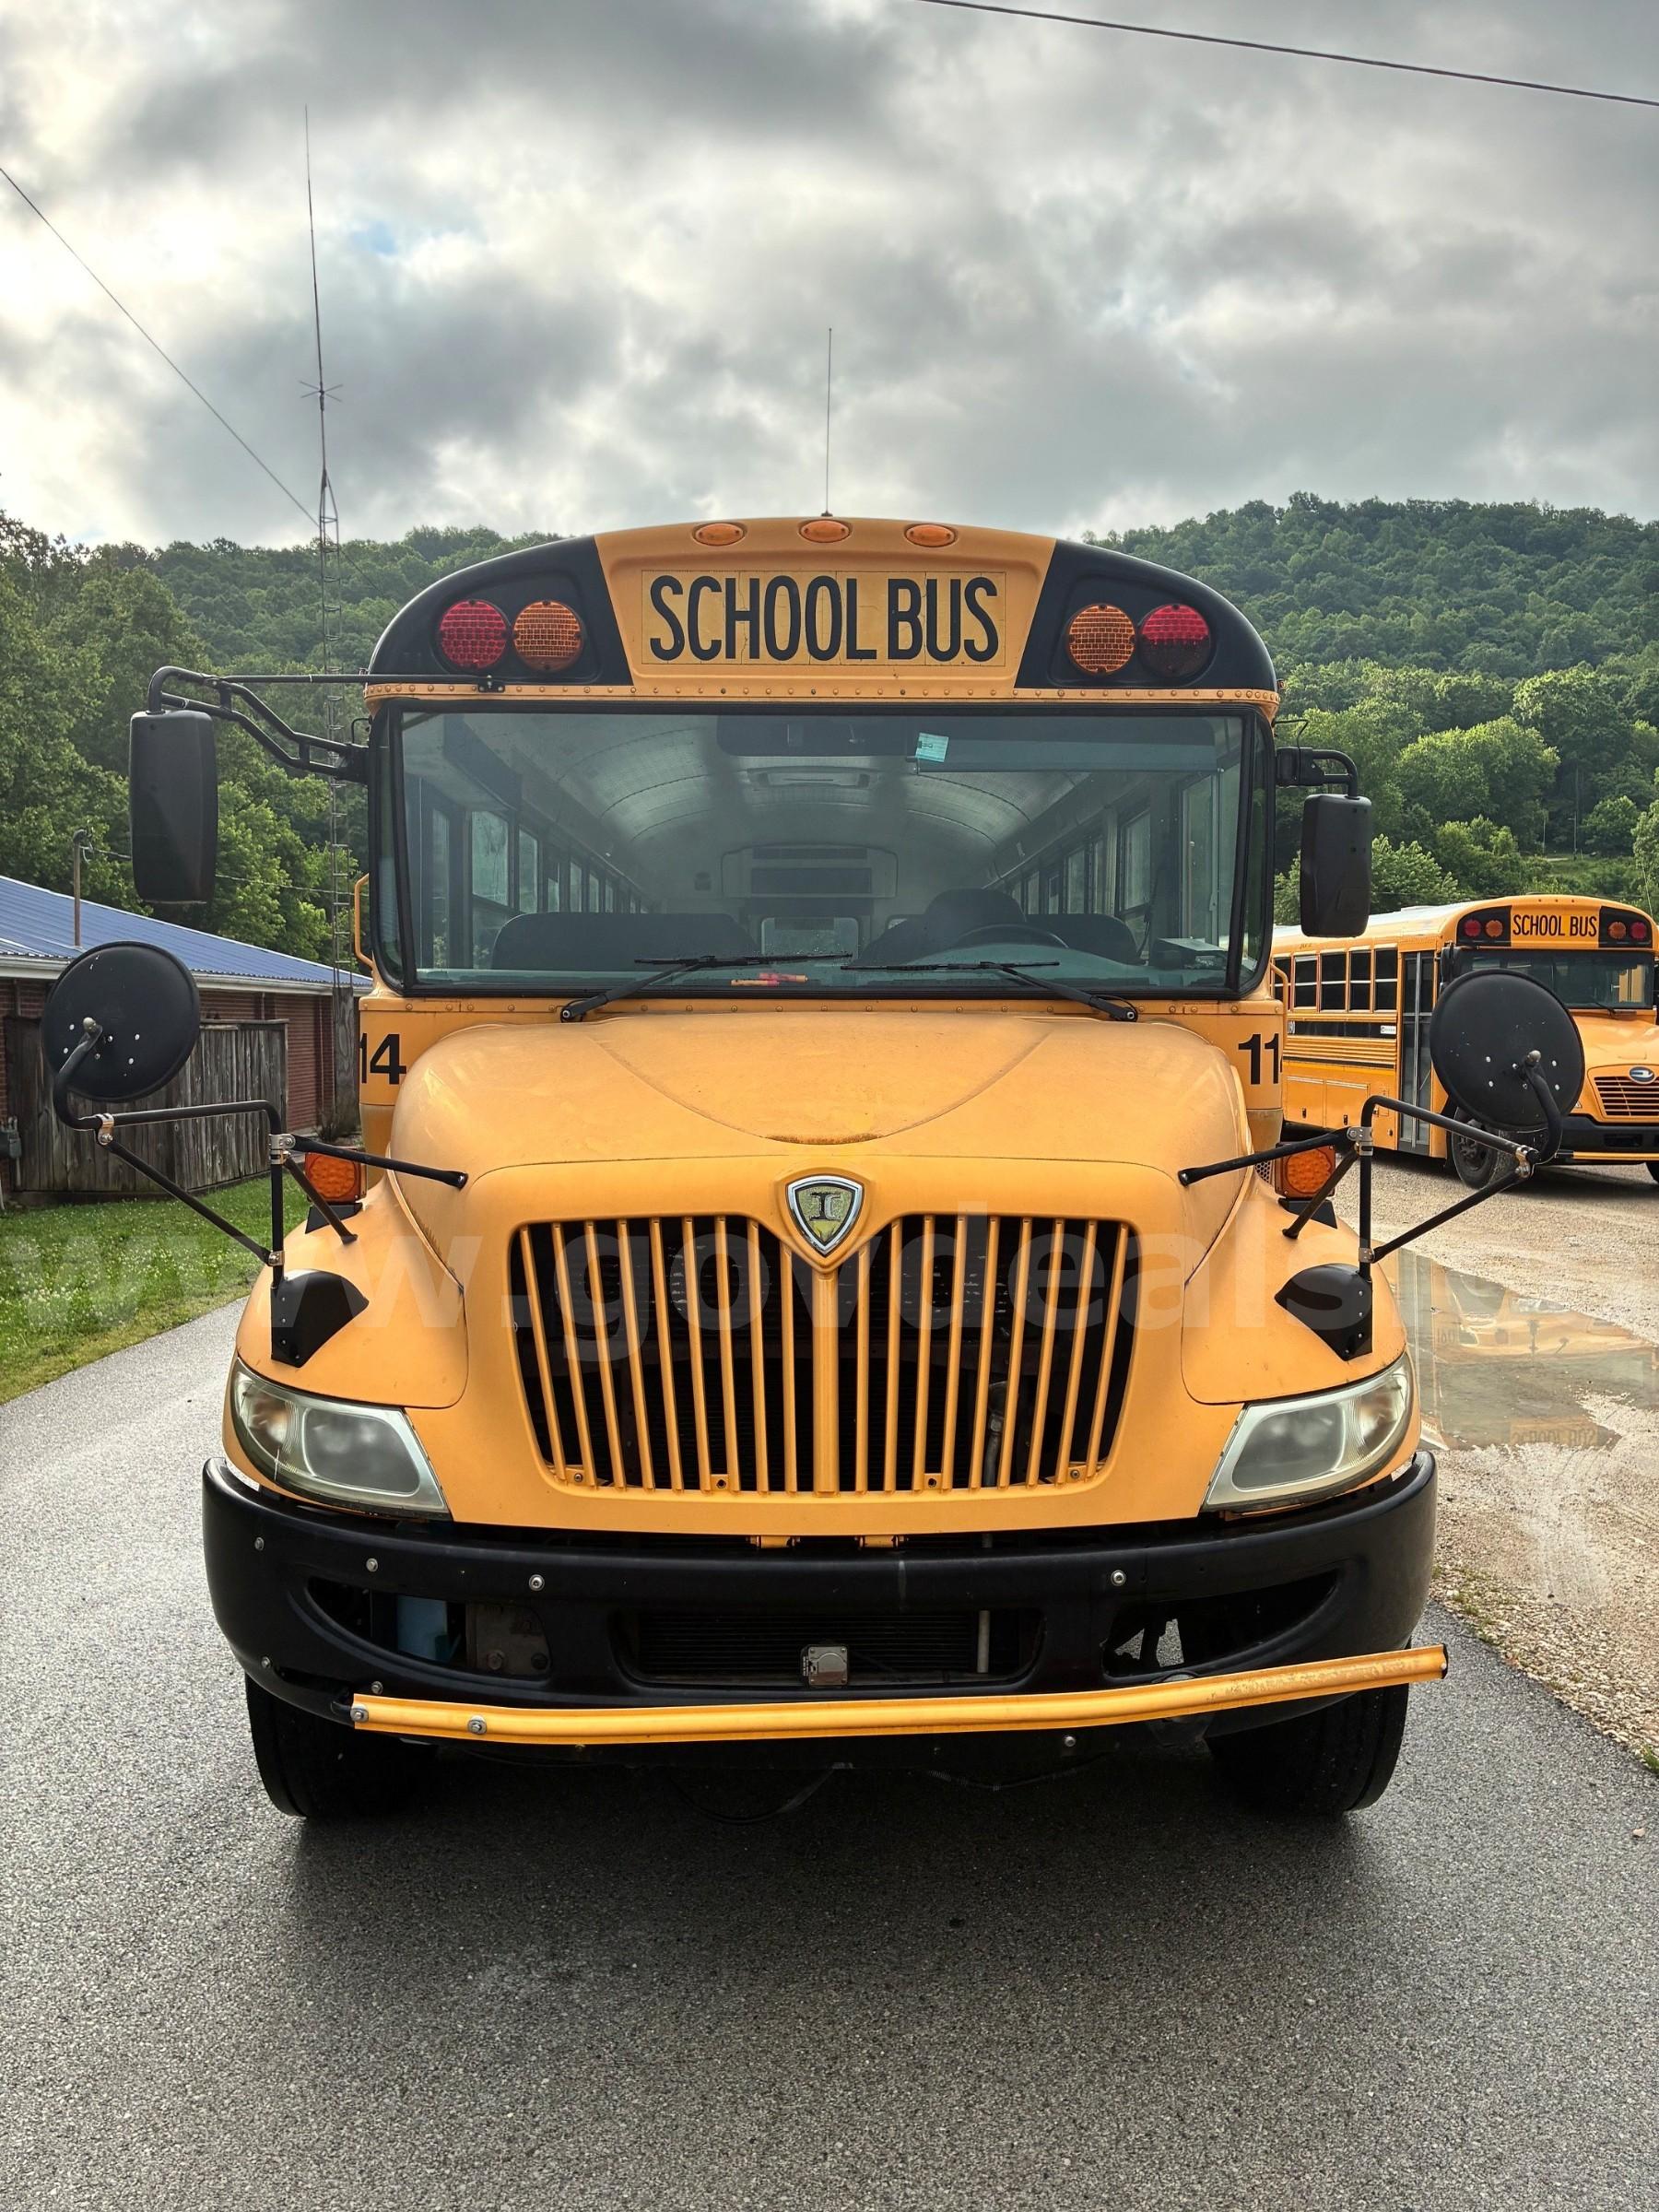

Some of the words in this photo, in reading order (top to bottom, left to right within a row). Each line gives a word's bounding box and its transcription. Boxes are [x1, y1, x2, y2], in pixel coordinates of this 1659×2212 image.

[649, 574, 877, 662] SCHOOL
[888, 577, 999, 663] BUS
[1512, 914, 1566, 936] SCHOOL
[1570, 915, 1597, 937] BUS
[359, 1032, 407, 1085] 14
[1238, 1032, 1283, 1085] 11
